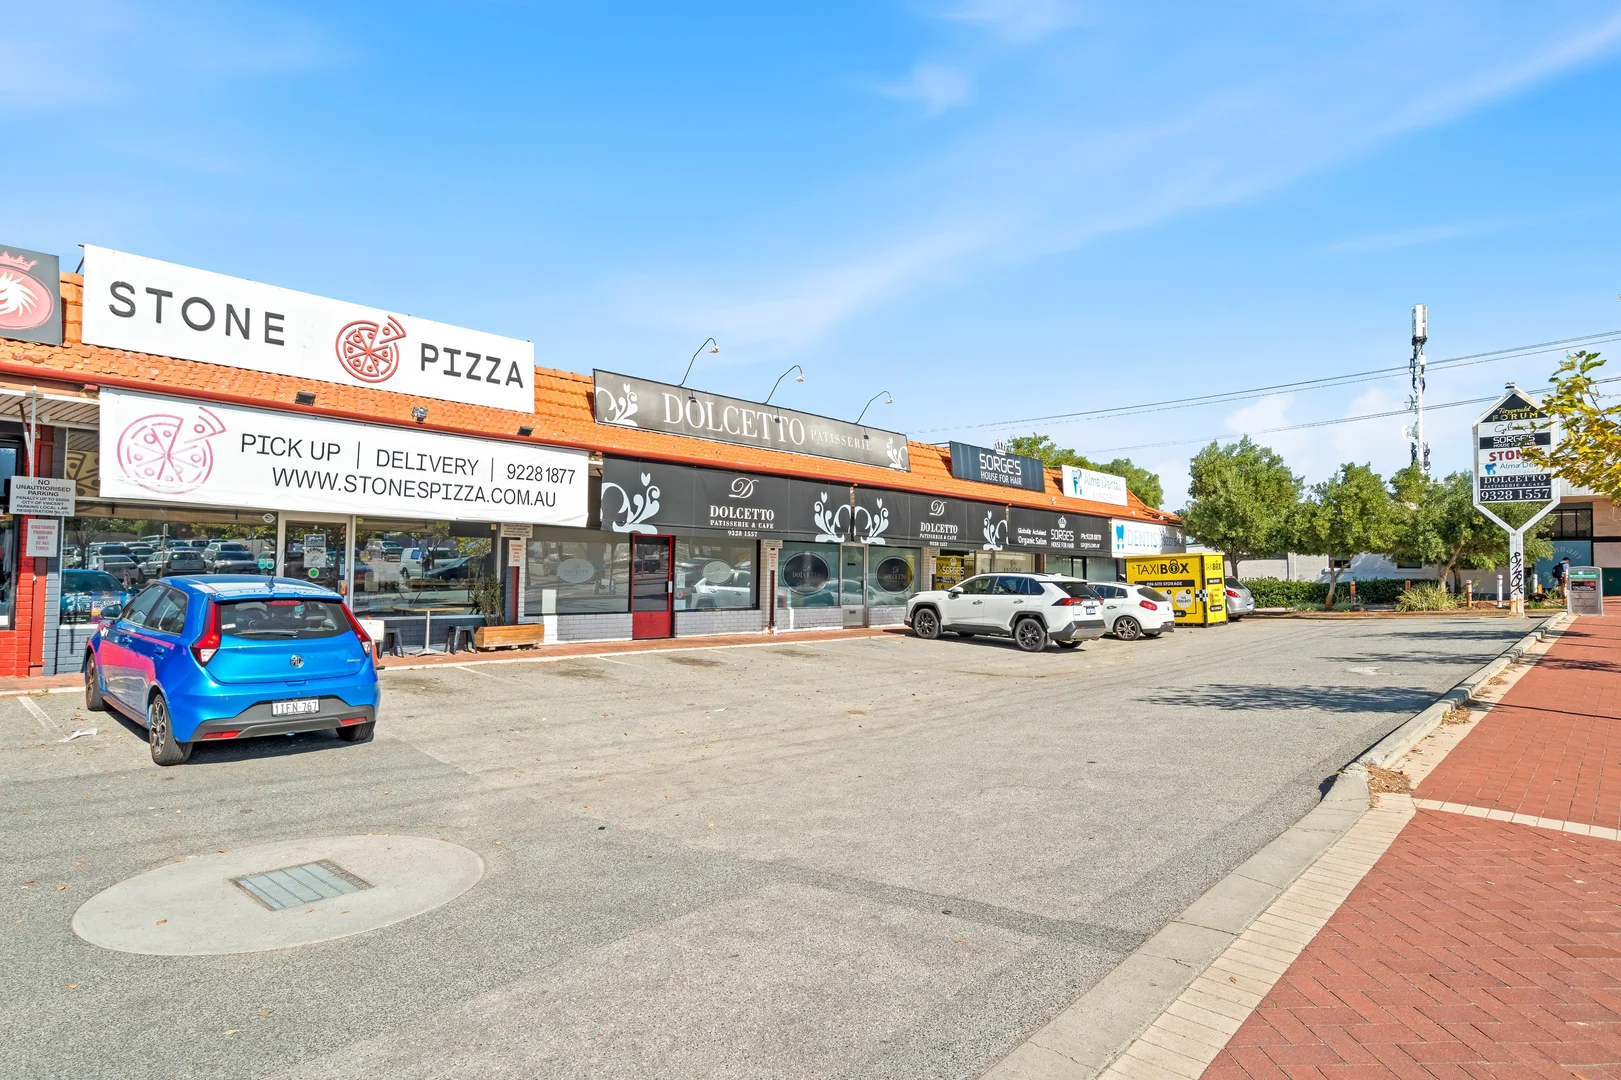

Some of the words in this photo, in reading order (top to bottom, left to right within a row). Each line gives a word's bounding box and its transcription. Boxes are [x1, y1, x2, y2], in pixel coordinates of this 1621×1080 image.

[108, 280, 285, 346] STONE
[420, 342, 524, 389] PIZZA
[661, 392, 806, 445] DOLCETTO
[1492, 412, 1538, 421] FORUM
[810, 429, 873, 451] PATISSERIE
[240, 433, 303, 458] PICK
[310, 440, 341, 462] UP
[376, 449, 480, 476] DELIVERY
[506, 463, 577, 485] 92281877
[979, 453, 1022, 476] SORGE'S
[1499, 462, 1520, 470] Alma
[272, 466, 557, 508] WWW.STONESPIZZA.COM.AU
[980, 471, 998, 482] HOUSE
[999, 474, 1009, 484] FOR
[1010, 476, 1022, 486] HAIR
[1084, 471, 1100, 487] Alma
[1101, 475, 1122, 492] Dental
[1484, 474, 1547, 484] DOLCETTO
[1481, 490, 1513, 501] 9328
[1518, 489, 1550, 500] 1557
[709, 505, 775, 522] DOLCETTO
[710, 519, 749, 528] PATISSERIE
[920, 522, 958, 534] DOLCETTO
[1017, 535, 1035, 546] Organic
[1136, 558, 1190, 576] TAXIBOX
